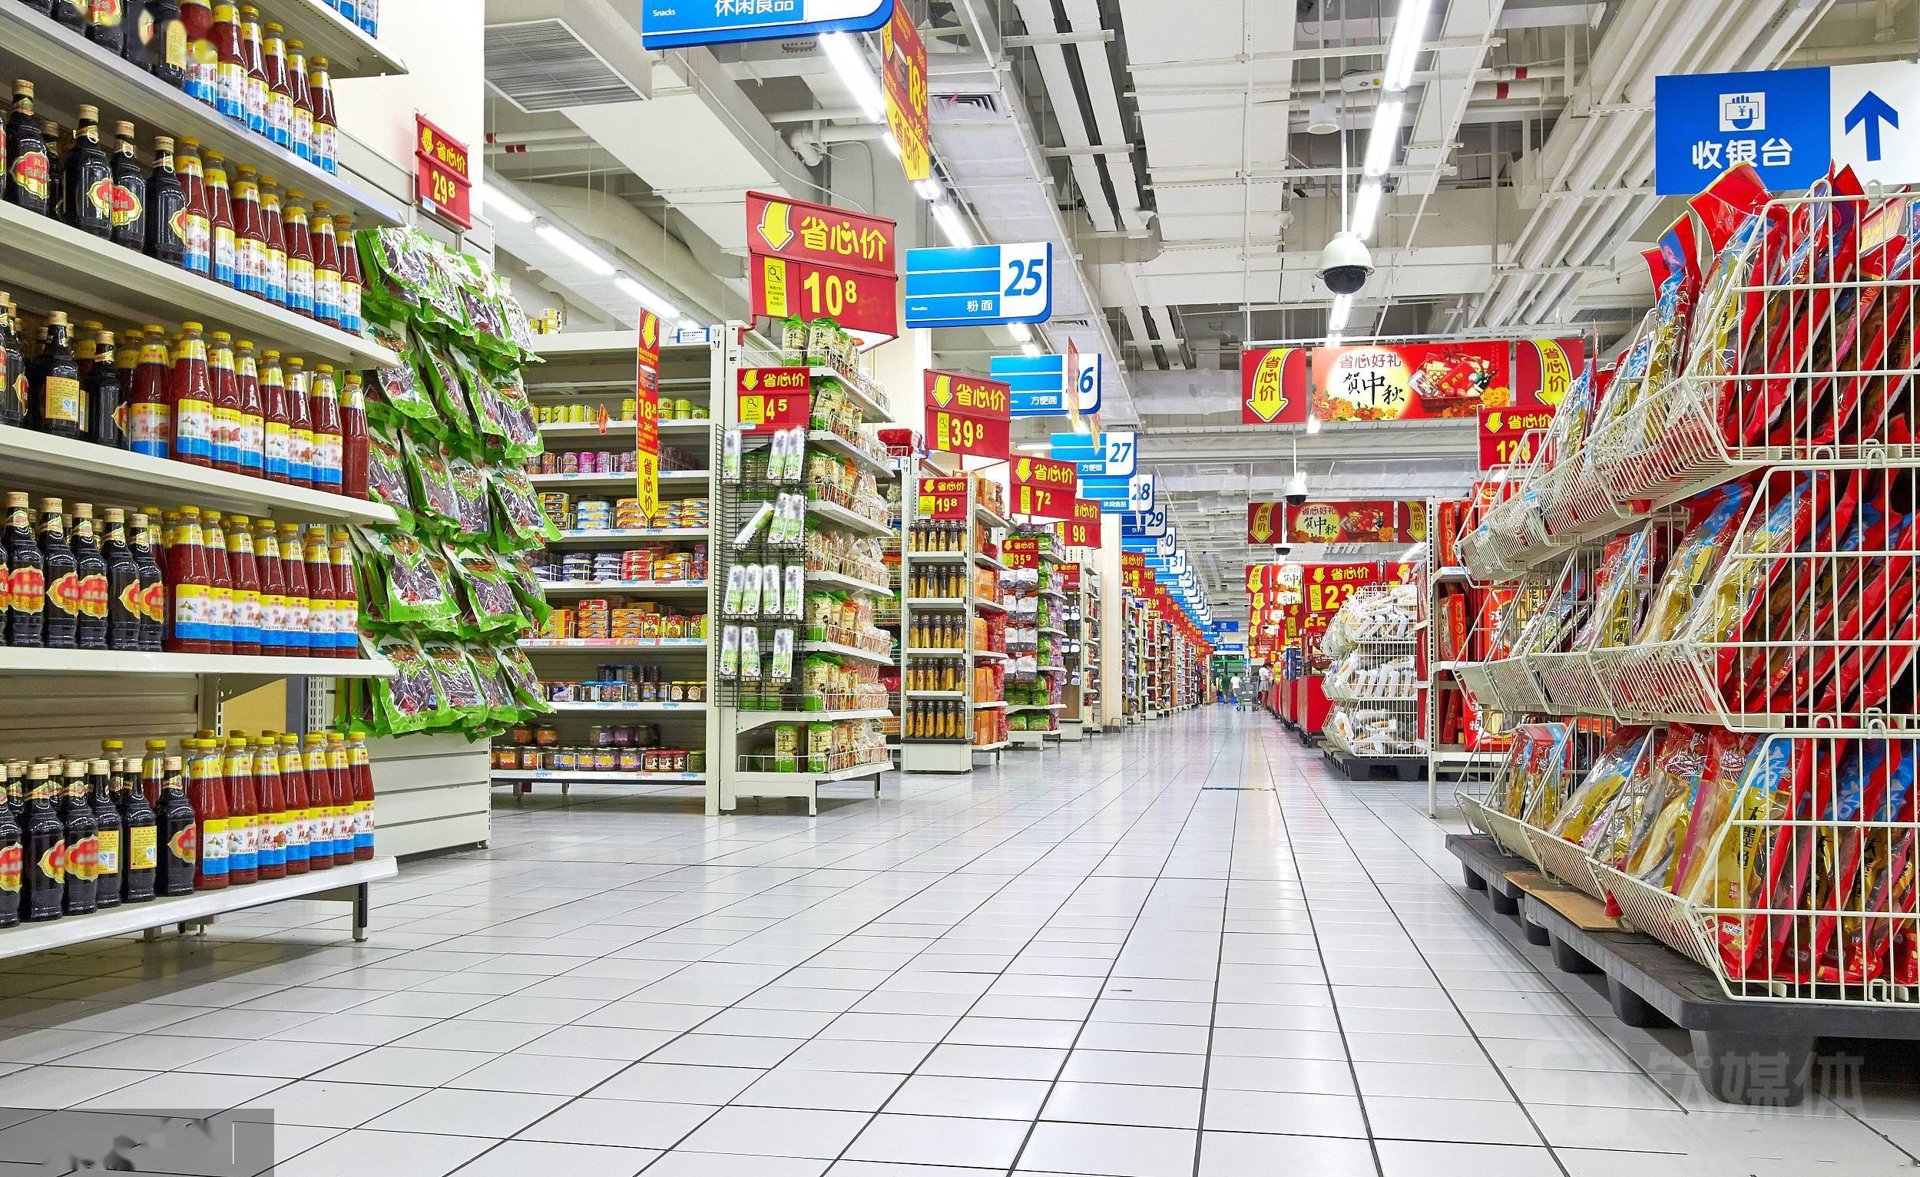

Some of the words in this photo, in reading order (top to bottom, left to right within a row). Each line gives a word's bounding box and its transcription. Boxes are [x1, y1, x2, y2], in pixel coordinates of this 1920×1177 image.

[652, 9, 676, 17] Snacks
[436, 140, 466, 175] 省心价
[1692, 137, 1793, 170] 收银台
[800, 215, 887, 262] 省心价
[1004, 258, 1044, 297] 25
[966, 299, 993, 312] 粉面
[1339, 352, 1402, 369] 省心好礼
[1543, 346, 1568, 393] 省心价
[763, 372, 806, 388] 省心价
[1258, 355, 1279, 402] 省心价
[1343, 371, 1405, 405] 贺中秋
[956, 384, 1005, 412] 省心价
[1030, 395, 1058, 406] 方便面
[1508, 413, 1553, 429] 省心价
[1108, 442, 1132, 463] 27
[1034, 464, 1074, 484] 省心价
[643, 458, 653, 512] 省心价
[937, 482, 965, 491] 省心价
[1147, 512, 1164, 527] 29
[1257, 506, 1270, 532] 省心价
[1302, 506, 1336, 515] 省心好礼
[1411, 506, 1424, 531] 省心价
[1072, 524, 1086, 543] 98
[1304, 516, 1338, 535] 贺中秋
[1014, 541, 1035, 550] 省心价
[1172, 555, 1183, 567] 31
[1331, 567, 1370, 580] 省心价
